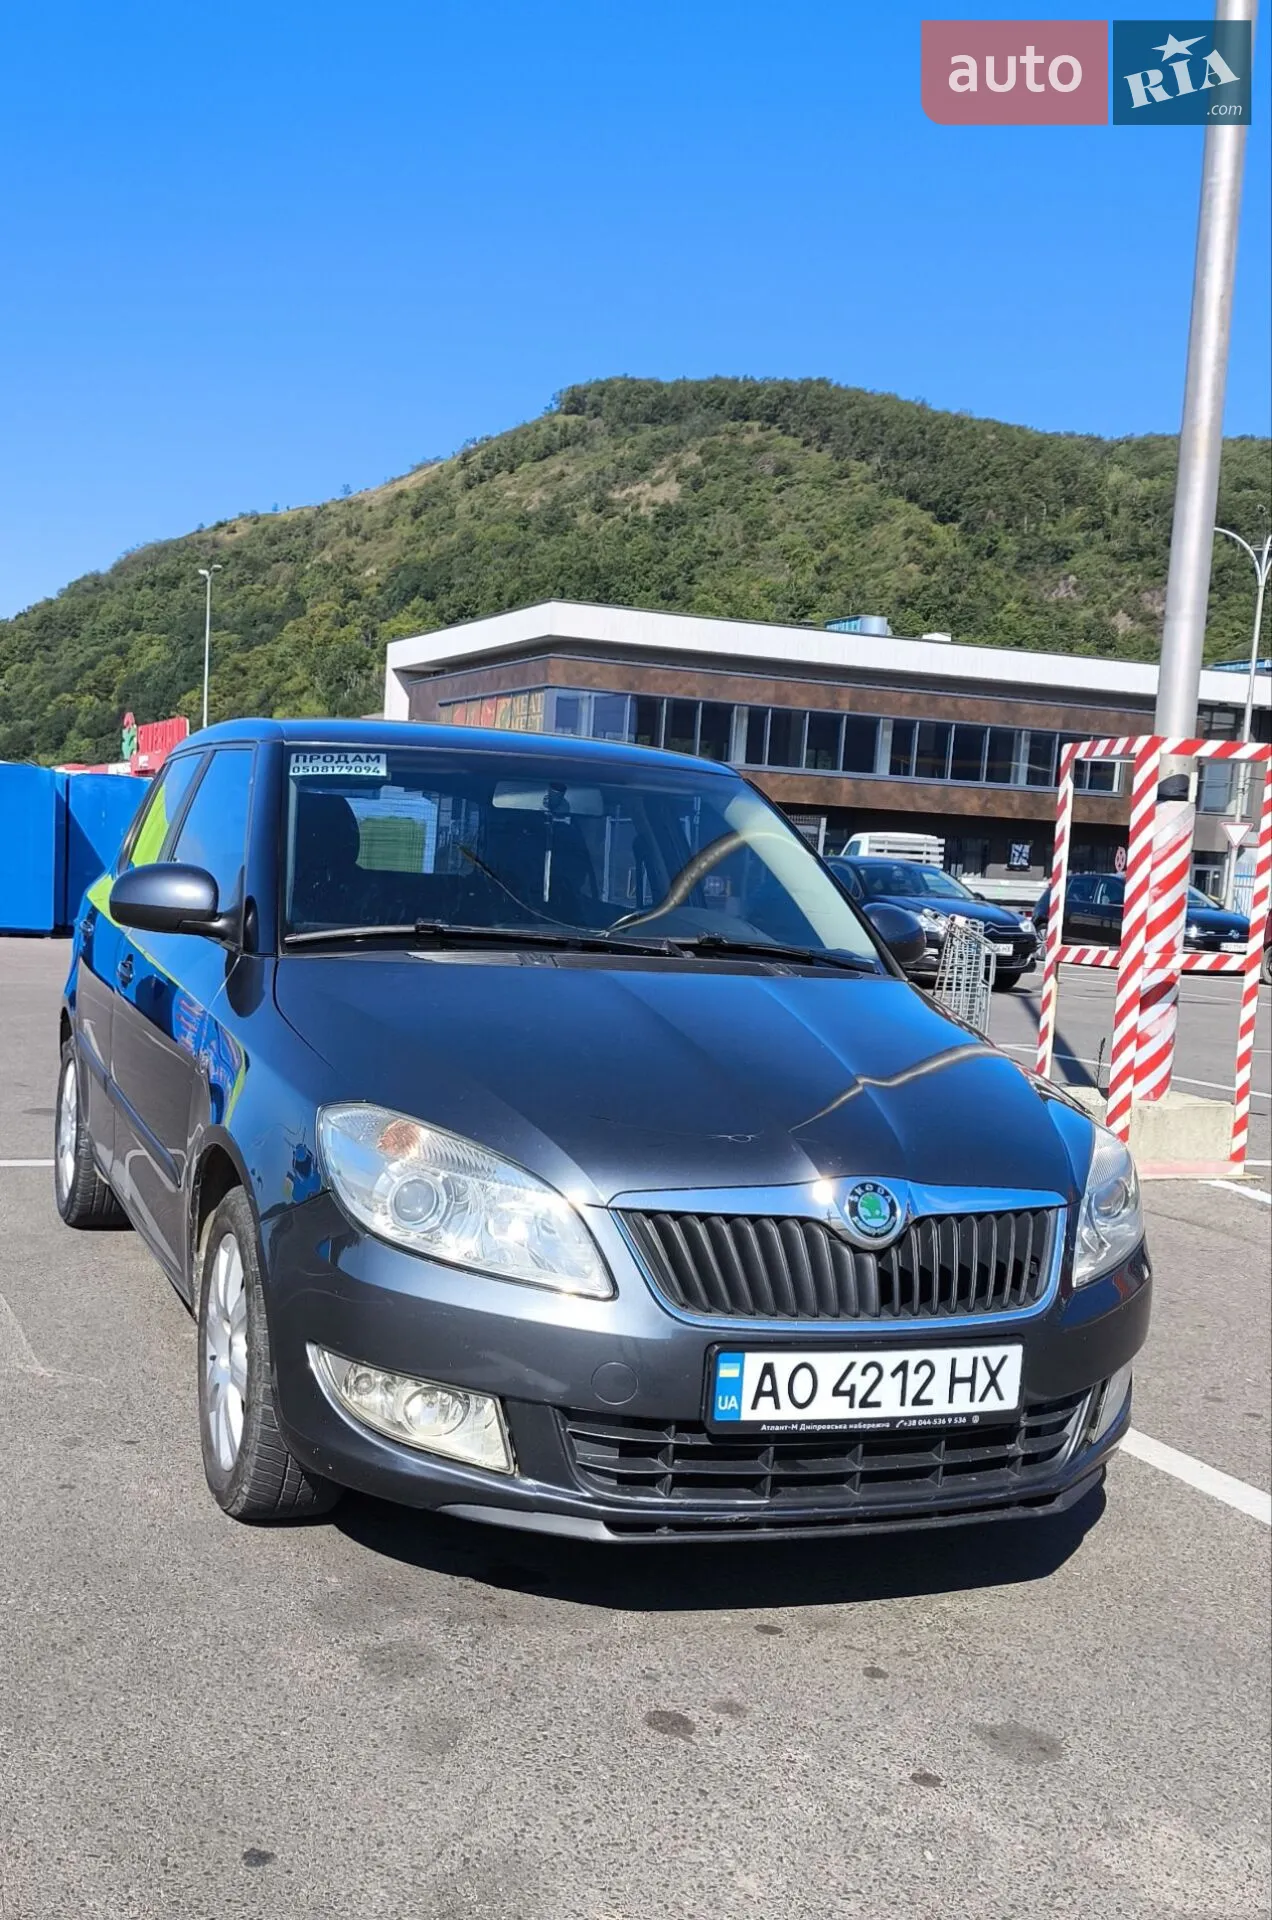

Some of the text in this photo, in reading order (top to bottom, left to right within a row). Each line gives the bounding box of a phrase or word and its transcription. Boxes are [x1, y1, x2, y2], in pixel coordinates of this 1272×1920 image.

[295, 754, 380, 764] ПРОДАМ
[292, 765, 380, 774] 0508179094
[750, 1354, 1008, 1410] AO 4212 HX
[718, 1396, 738, 1410] UA
[761, 1423, 798, 1431] Атлант-М
